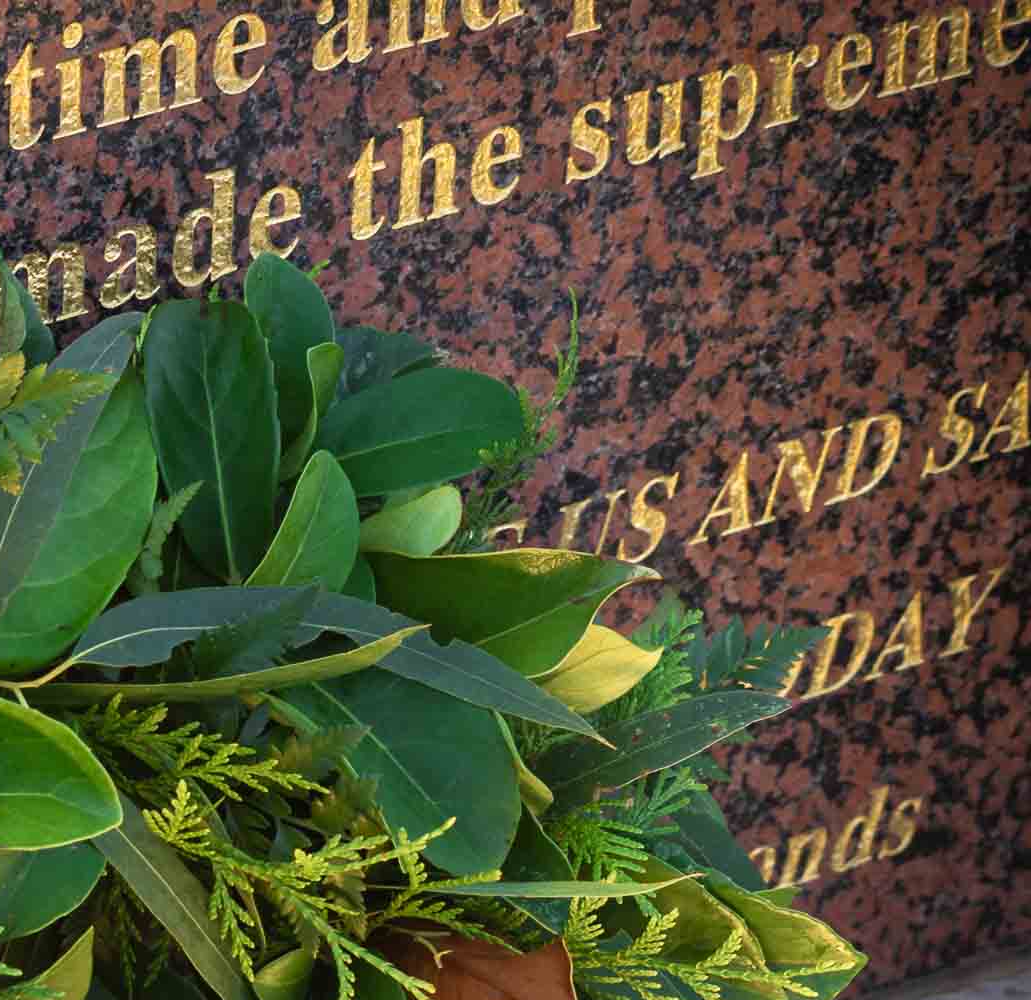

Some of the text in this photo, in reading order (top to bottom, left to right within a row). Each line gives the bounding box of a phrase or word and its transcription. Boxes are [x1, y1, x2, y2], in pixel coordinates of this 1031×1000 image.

[349, 116, 524, 241] the
[566, 0, 1031, 184] supreme
[560, 470, 680, 564] US
[686, 413, 904, 546] AND
